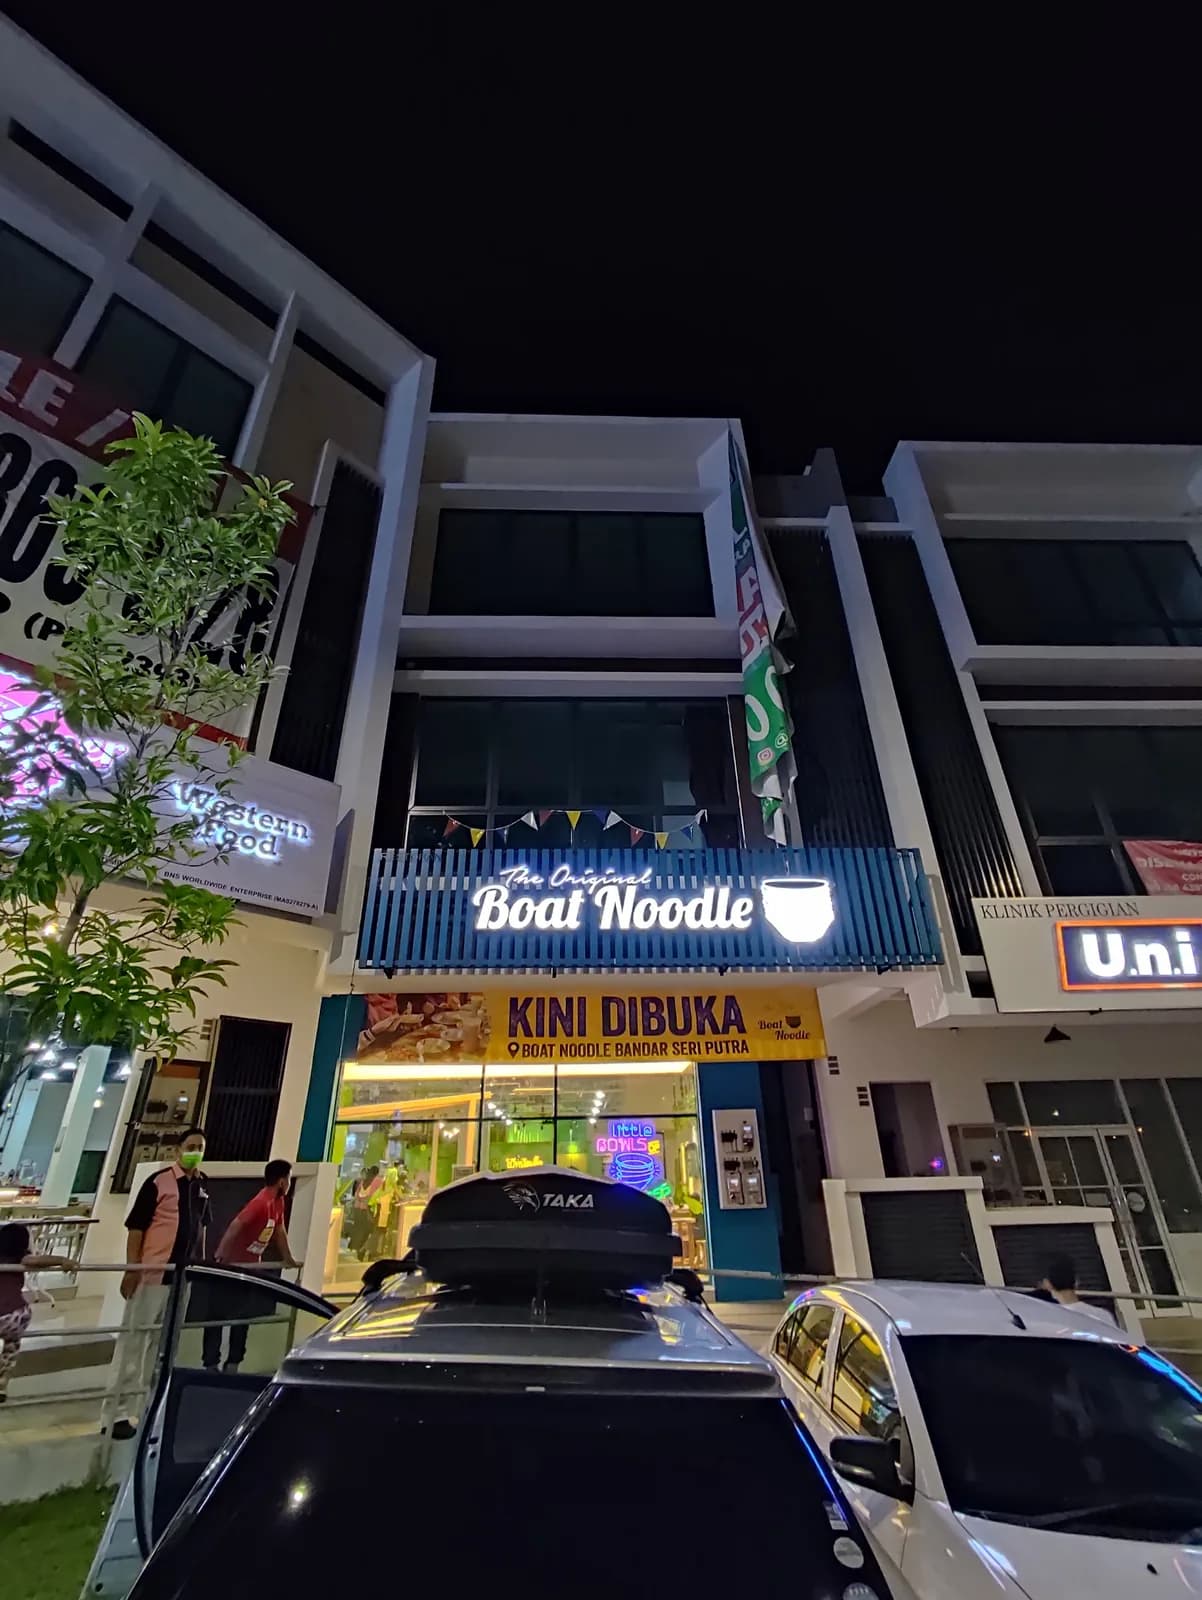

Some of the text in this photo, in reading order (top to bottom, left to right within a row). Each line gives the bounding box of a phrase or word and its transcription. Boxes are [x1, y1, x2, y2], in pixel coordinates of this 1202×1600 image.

[176, 782, 309, 839] Western
[204, 819, 277, 856] Food
[182, 874, 227, 890] WORLDWIDE
[230, 886, 272, 900] ENTERPRISE
[500, 863, 652, 895] The Original
[473, 885, 753, 930] Boat Noodle
[981, 902, 1140, 919] KLINIK PERGIGIAN
[509, 995, 747, 1037] KINI DIBUKA
[758, 1019, 782, 1030] Boat
[775, 1029, 810, 1041] Noodle
[522, 1040, 749, 1058] BOAT NOODLE BANDAR SERI PUTRA
[596, 1138, 647, 1152] BOWLS
[542, 1193, 594, 1208] TAKA
